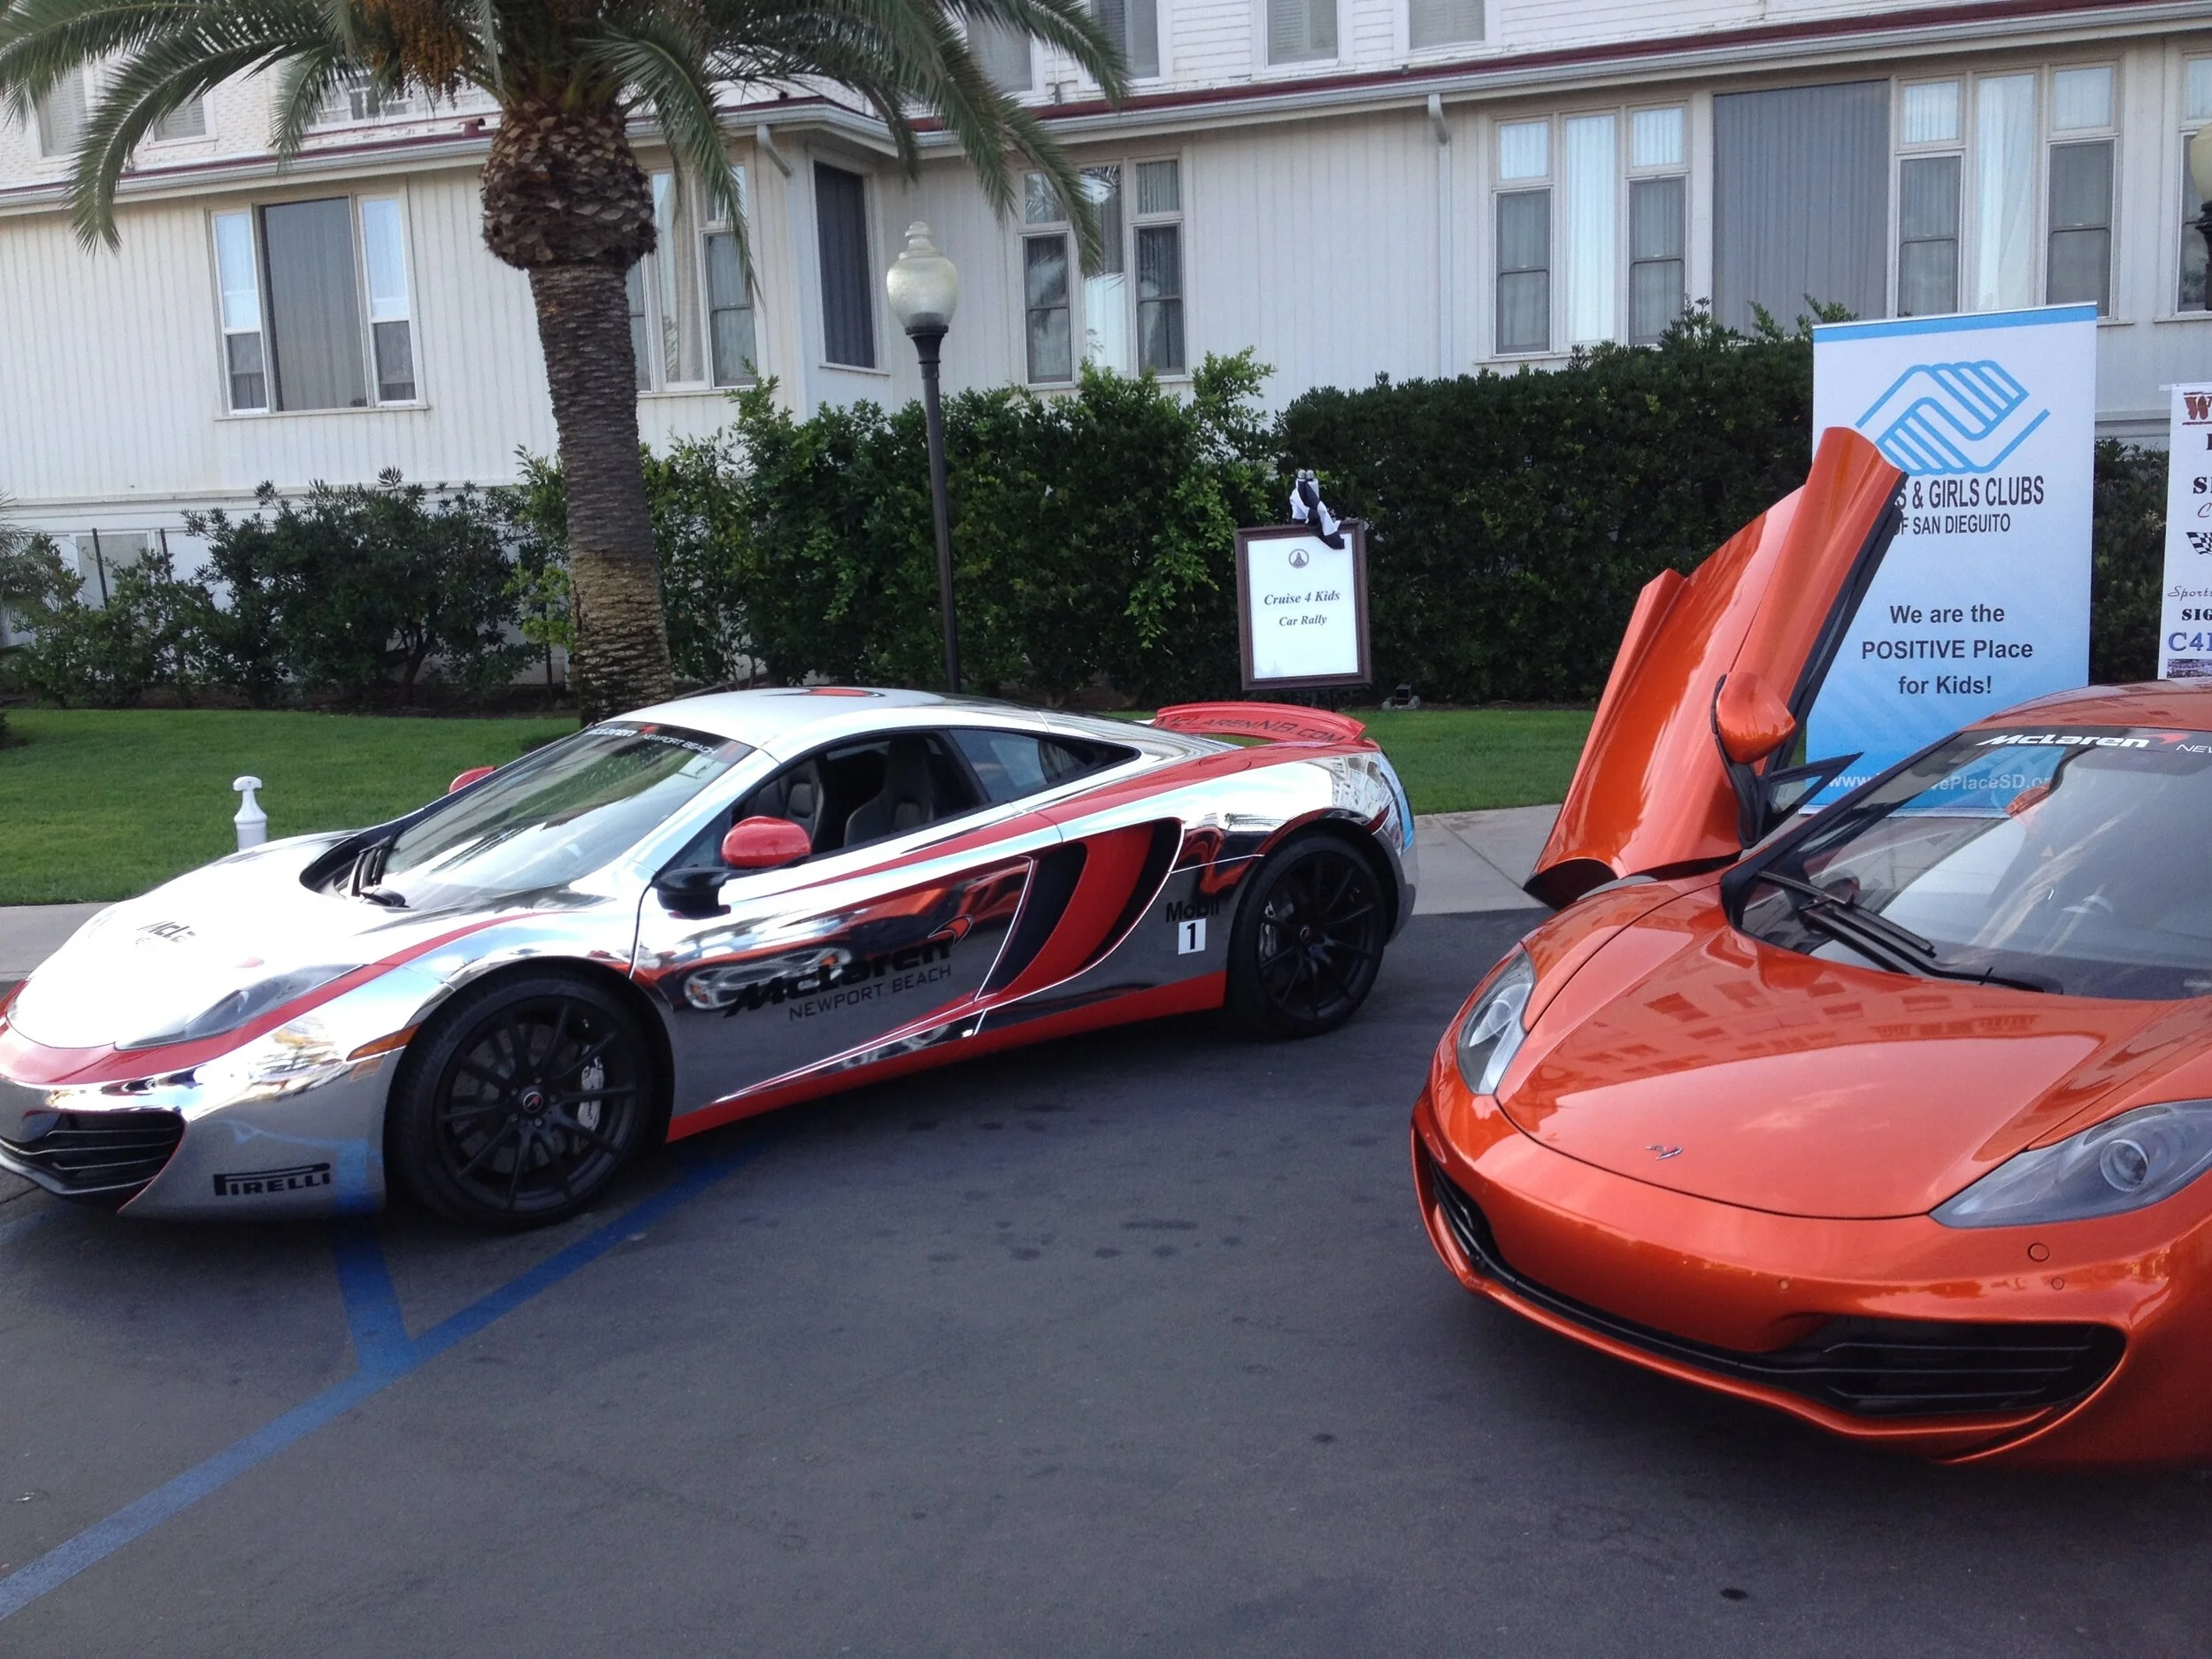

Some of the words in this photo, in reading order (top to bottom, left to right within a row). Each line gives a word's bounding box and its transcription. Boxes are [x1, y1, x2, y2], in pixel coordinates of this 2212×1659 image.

[1912, 480, 1924, 510] &
[1929, 478, 1980, 509] GIRLS
[1985, 475, 2045, 506] CLUBS
[1912, 516, 1940, 535] SAN
[1945, 513, 2011, 534] DIEGUITO
[1263, 594, 1302, 605] Cruise
[1304, 592, 1311, 603] 4
[1315, 590, 1340, 602] Kids
[1279, 616, 1298, 626] Car
[1301, 614, 1327, 626] Rally
[1890, 605, 1922, 624] We
[1930, 608, 1963, 623] are
[1970, 603, 2005, 623] the
[1862, 640, 1965, 659] POSITIVE
[1973, 640, 2033, 658] Place
[1899, 676, 1929, 695] for
[1936, 675, 1992, 695] Kids!
[682, 741, 718, 755] BEACH
[1975, 733, 2150, 748] McLaren
[1187, 922, 1196, 950] 1
[789, 985, 884, 1021] NEWPORT
[892, 964, 951, 994] BEACH
[213, 1162, 331, 1196] PIRELLI
